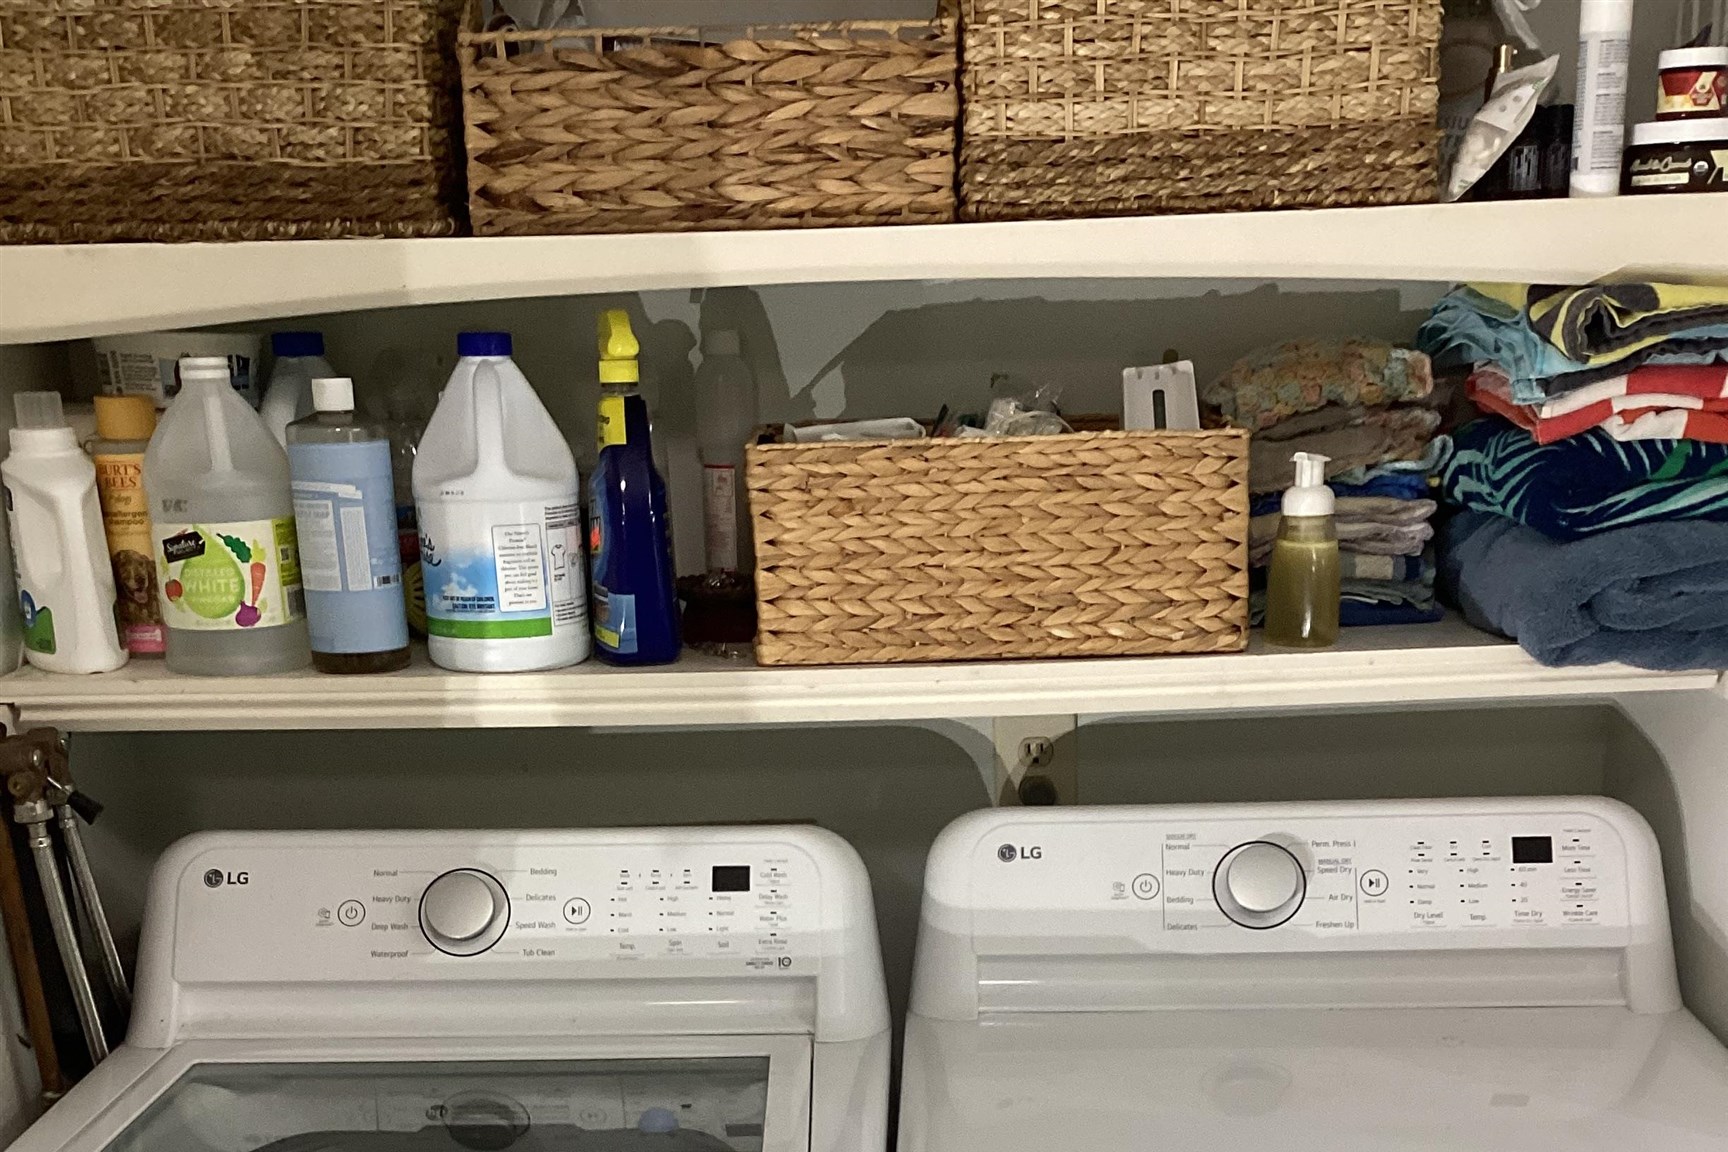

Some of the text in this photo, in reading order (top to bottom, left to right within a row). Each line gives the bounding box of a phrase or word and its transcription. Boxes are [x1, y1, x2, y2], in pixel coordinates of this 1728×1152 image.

[185, 578, 240, 593] WHITE
[1312, 840, 1352, 848] Perm. Press
[1020, 846, 1042, 860] LG
[530, 868, 558, 876] Bedding
[1166, 868, 1204, 878] Heavy Duty
[1317, 866, 1352, 875] Speed Dry
[227, 872, 248, 884] LG
[394, 895, 411, 904] Duty
[526, 894, 556, 902] Delicates
[1166, 896, 1194, 905] Bedding
[1328, 894, 1353, 902] Air Dry
[1414, 912, 1426, 920] Dry
[1530, 910, 1542, 918] Dry
[372, 922, 408, 932] Deep Wash
[515, 921, 556, 930] Speed Wash
[1167, 922, 1198, 930] Delicates
[1316, 920, 1354, 929] Freshen Up
[370, 950, 408, 958] Waterproof
[522, 948, 556, 956] Tub Clean
